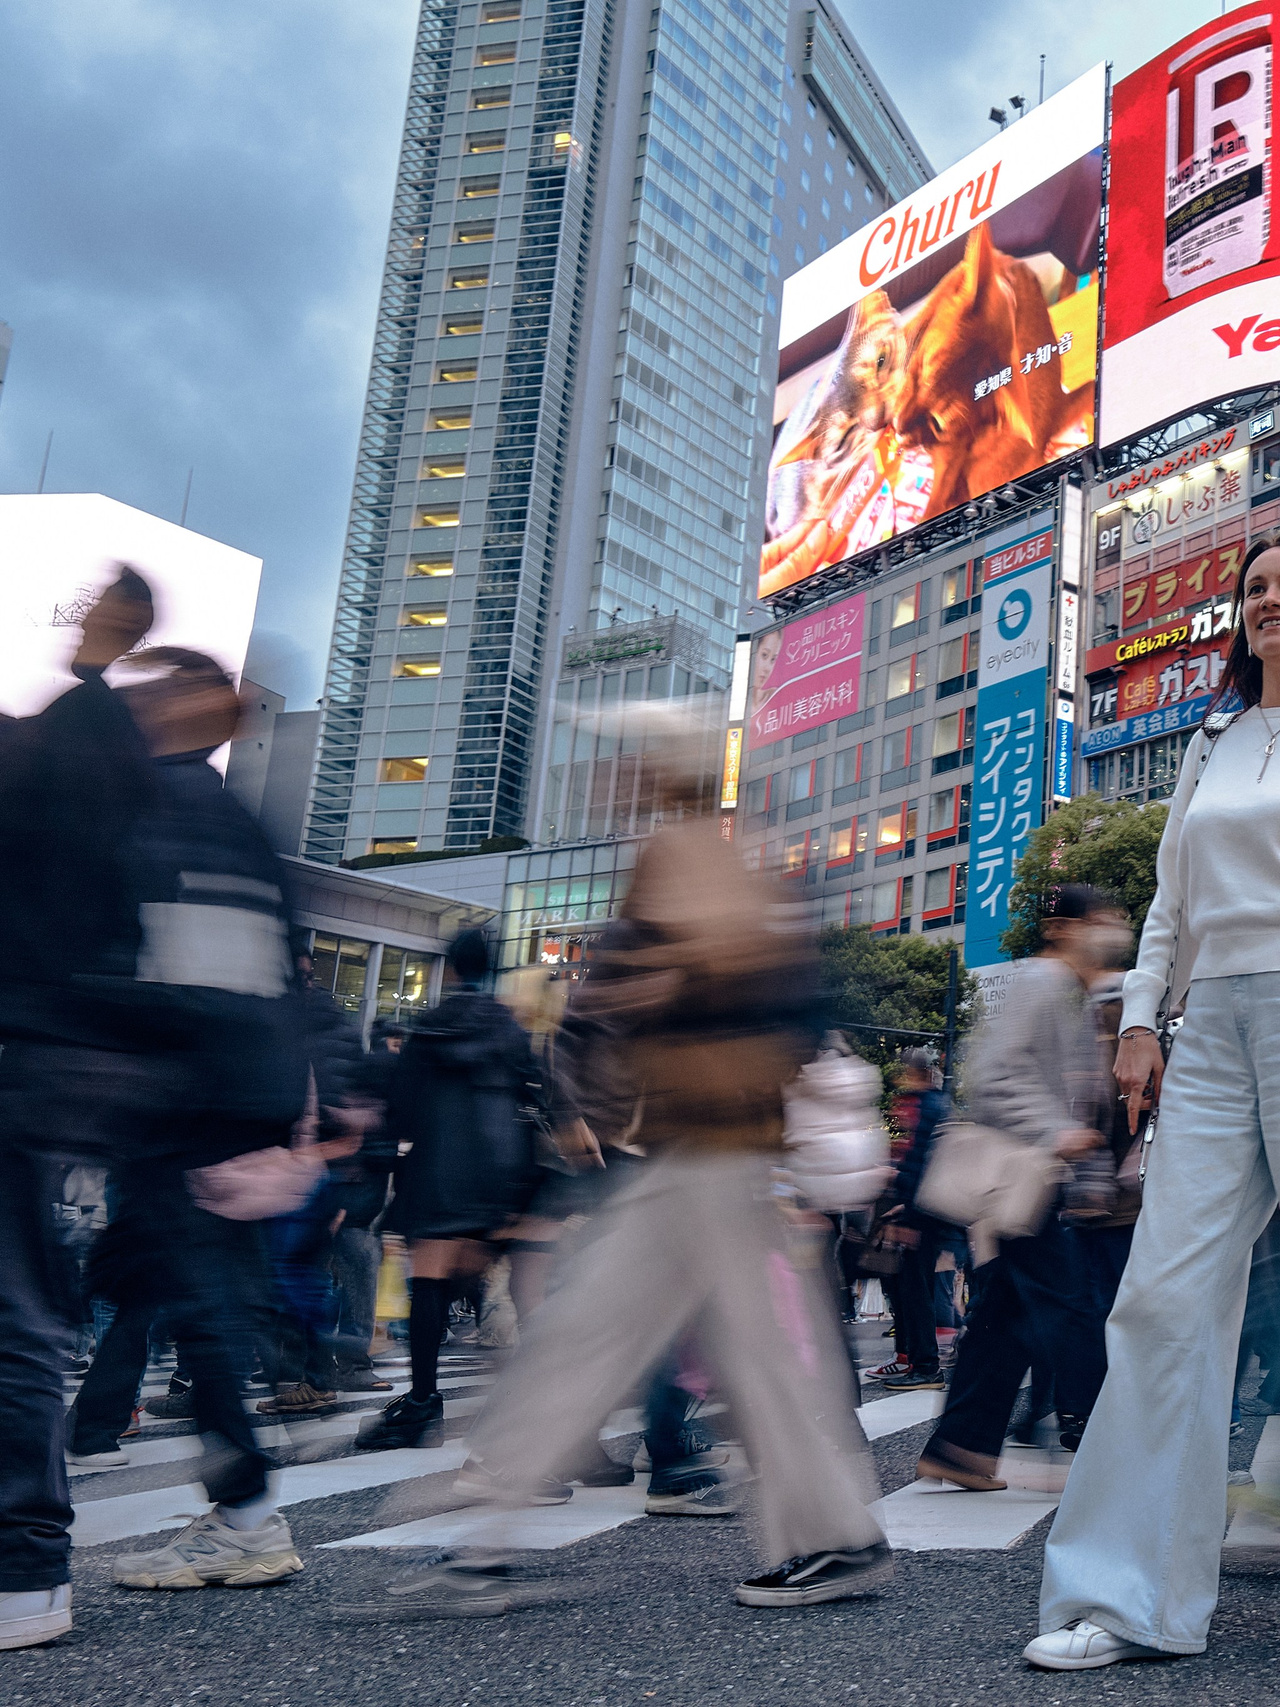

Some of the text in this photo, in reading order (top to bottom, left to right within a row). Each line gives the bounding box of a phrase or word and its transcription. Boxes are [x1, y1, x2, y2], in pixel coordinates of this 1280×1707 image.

[859, 159, 1003, 288] Churu
[974, 366, 1013, 401] 愛知県
[1107, 428, 1237, 499] しゃぶしゃぶバイキング
[1166, 469, 1242, 526] しゃぶ葉
[990, 536, 1047, 577] 当ビル5F
[1099, 526, 1121, 551] 9F
[1124, 546, 1241, 619] プライス
[802, 608, 860, 647] 品川スキン
[1190, 601, 1242, 643] ガス
[801, 631, 852, 667] クリニック
[986, 637, 1041, 672] eyecity
[1123, 675, 1156, 700] Café
[1158, 649, 1228, 707] ガスト
[764, 678, 855, 735] 品川美容外科
[1091, 687, 1118, 717] 7F
[1087, 726, 1122, 750] AEON
[976, 714, 1011, 917] アイシティ
[516, 902, 614, 925] MARK CI
[977, 972, 1017, 989] CONTACT
[985, 989, 1006, 1003] LENS
